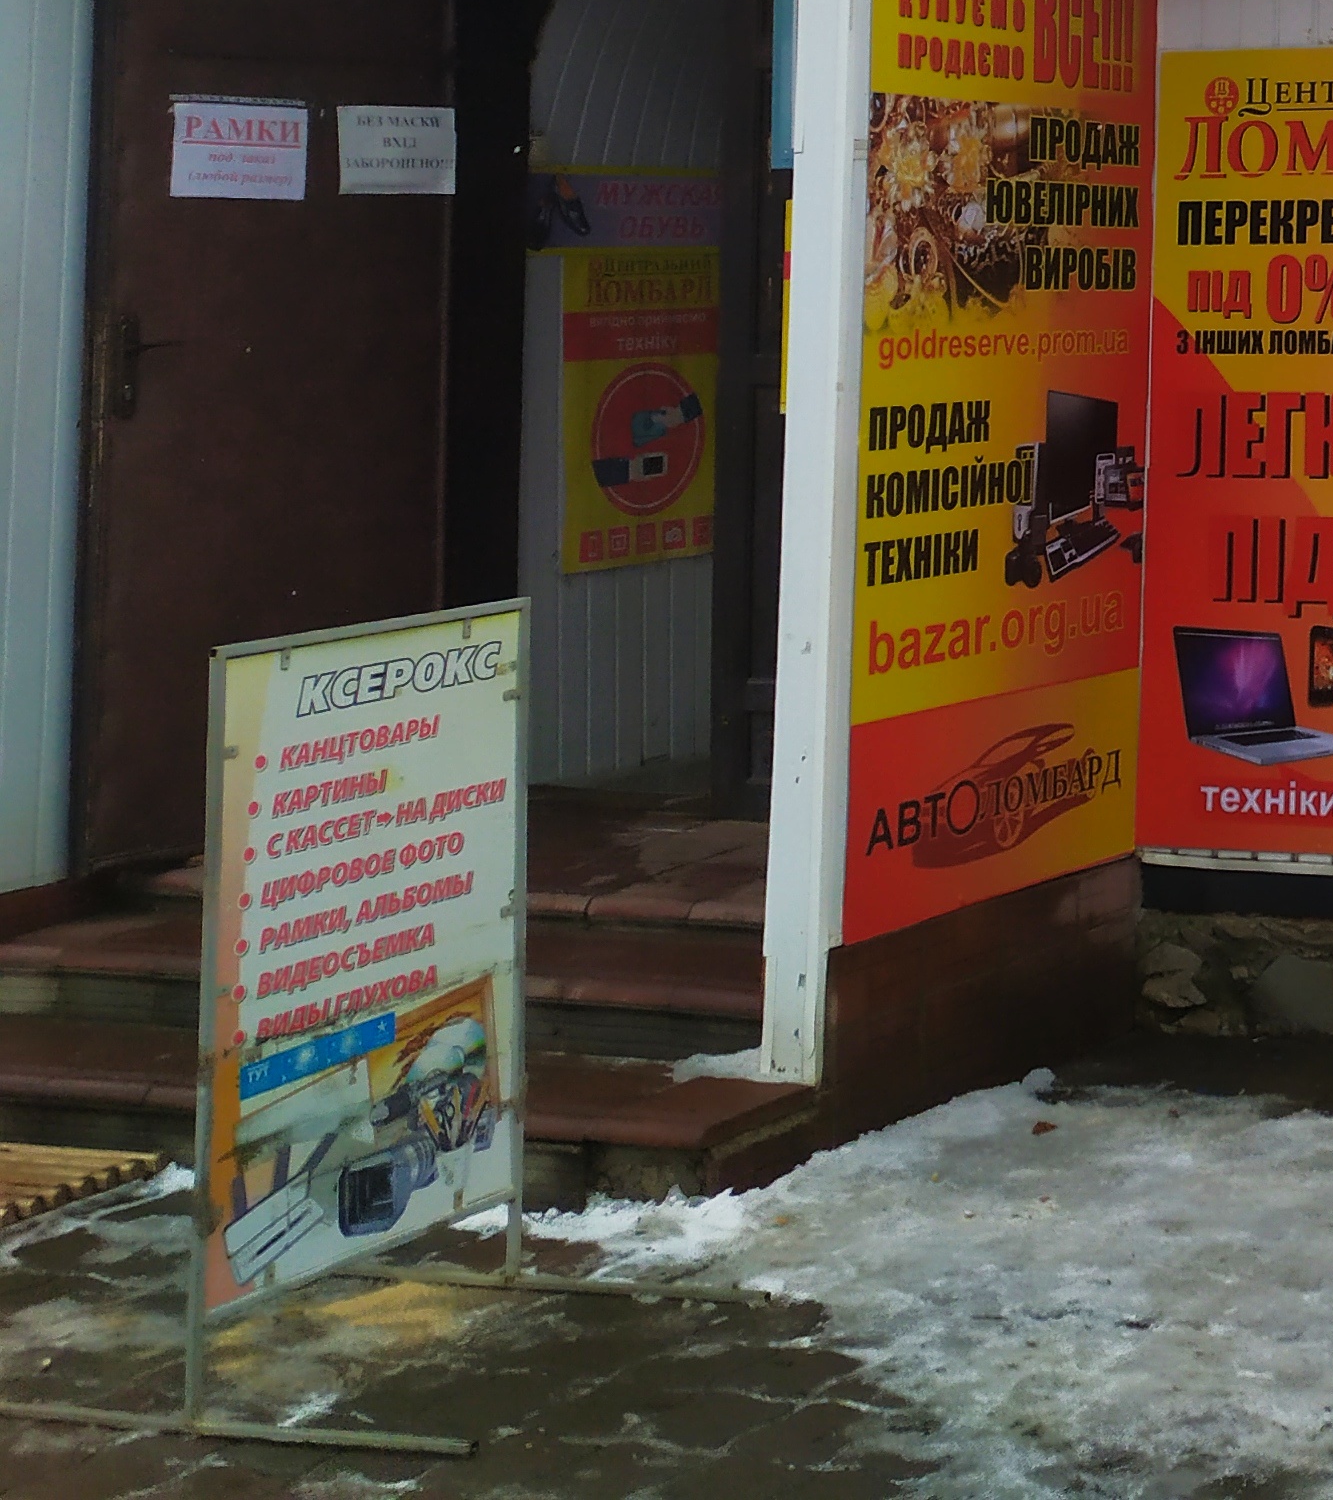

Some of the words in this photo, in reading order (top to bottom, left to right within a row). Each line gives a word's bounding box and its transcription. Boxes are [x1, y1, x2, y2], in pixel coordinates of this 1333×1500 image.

[898, 32, 1025, 81] ПРОДАЄМО
[185, 115, 301, 143] РАМКИ
[1029, 115, 1140, 171] ПРОДАЖ
[985, 178, 1140, 228] ЮВЕЛІРНИХ
[1024, 246, 1137, 292] ВИРОБІВ
[1187, 270, 1252, 318] ПІД
[878, 328, 1129, 369] goldreserve.prom.ua
[1195, 330, 1263, 355] ІНШИХ
[868, 400, 991, 453] ПРОДАЖ
[866, 450, 1035, 519] КОМІСІЙНОЇ
[864, 529, 979, 586] ТЕХНІКИ
[868, 590, 1125, 675] bazar.org.ua
[296, 641, 501, 717] КСЕРОКС
[279, 714, 440, 770] КАНЦТОВАРЫ
[266, 832, 284, 858] С
[285, 811, 377, 852] КАССЕТ
[396, 798, 426, 827] НА
[429, 778, 507, 820] ДИСКИ
[272, 769, 387, 818] КАРТИНЫ
[866, 748, 1122, 857] АВТОЛОМБАРД
[260, 847, 395, 908] ЦИФРОВОЕ
[399, 831, 464, 866] ФОТО
[259, 903, 352, 954] РАМКИ,
[356, 872, 474, 924] АЛЬБОМЫ
[257, 923, 434, 1000] ВИДЕОСЪЕМКА
[256, 996, 331, 1042] ВИДЫ
[331, 965, 438, 1019] ГЛУХОВА
